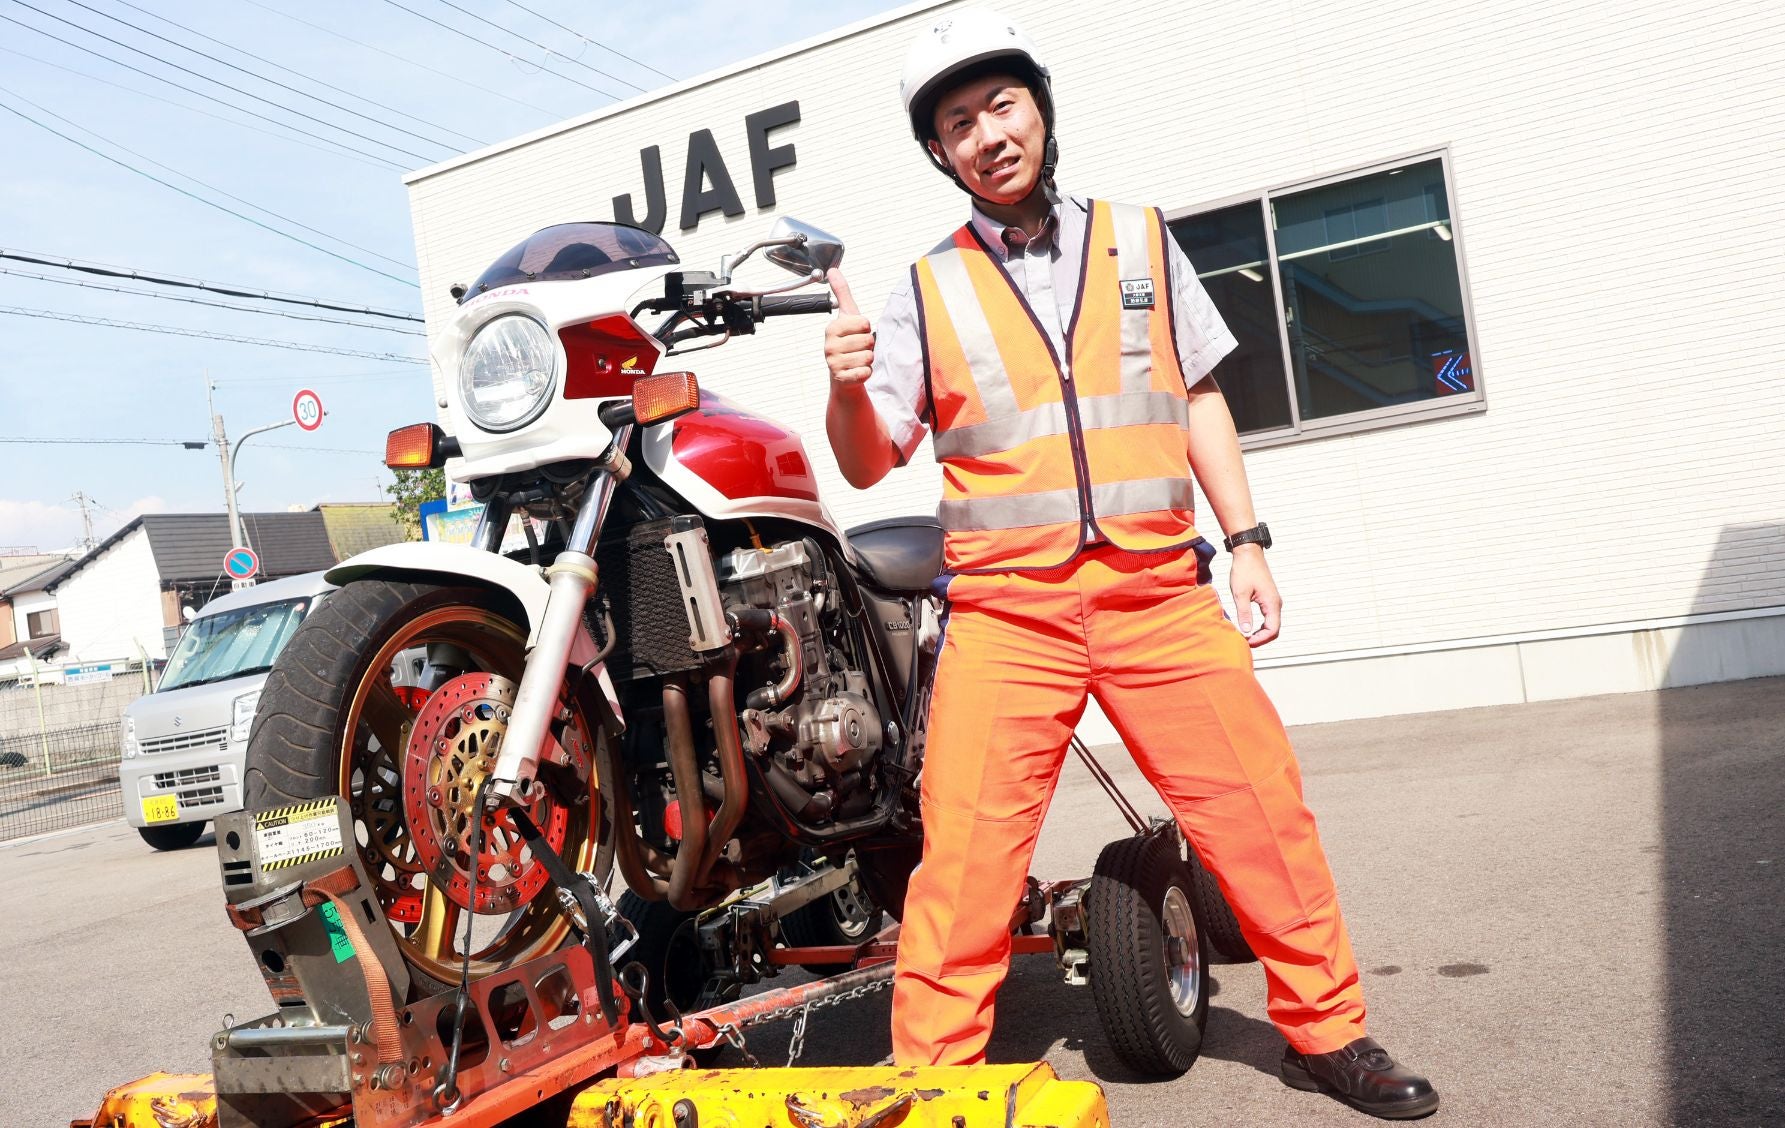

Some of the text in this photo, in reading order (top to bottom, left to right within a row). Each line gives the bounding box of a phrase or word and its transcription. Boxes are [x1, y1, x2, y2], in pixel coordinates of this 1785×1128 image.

[612, 100, 801, 238] JAF
[299, 400, 317, 420] 30
[264, 819, 287, 828] CAUTION
